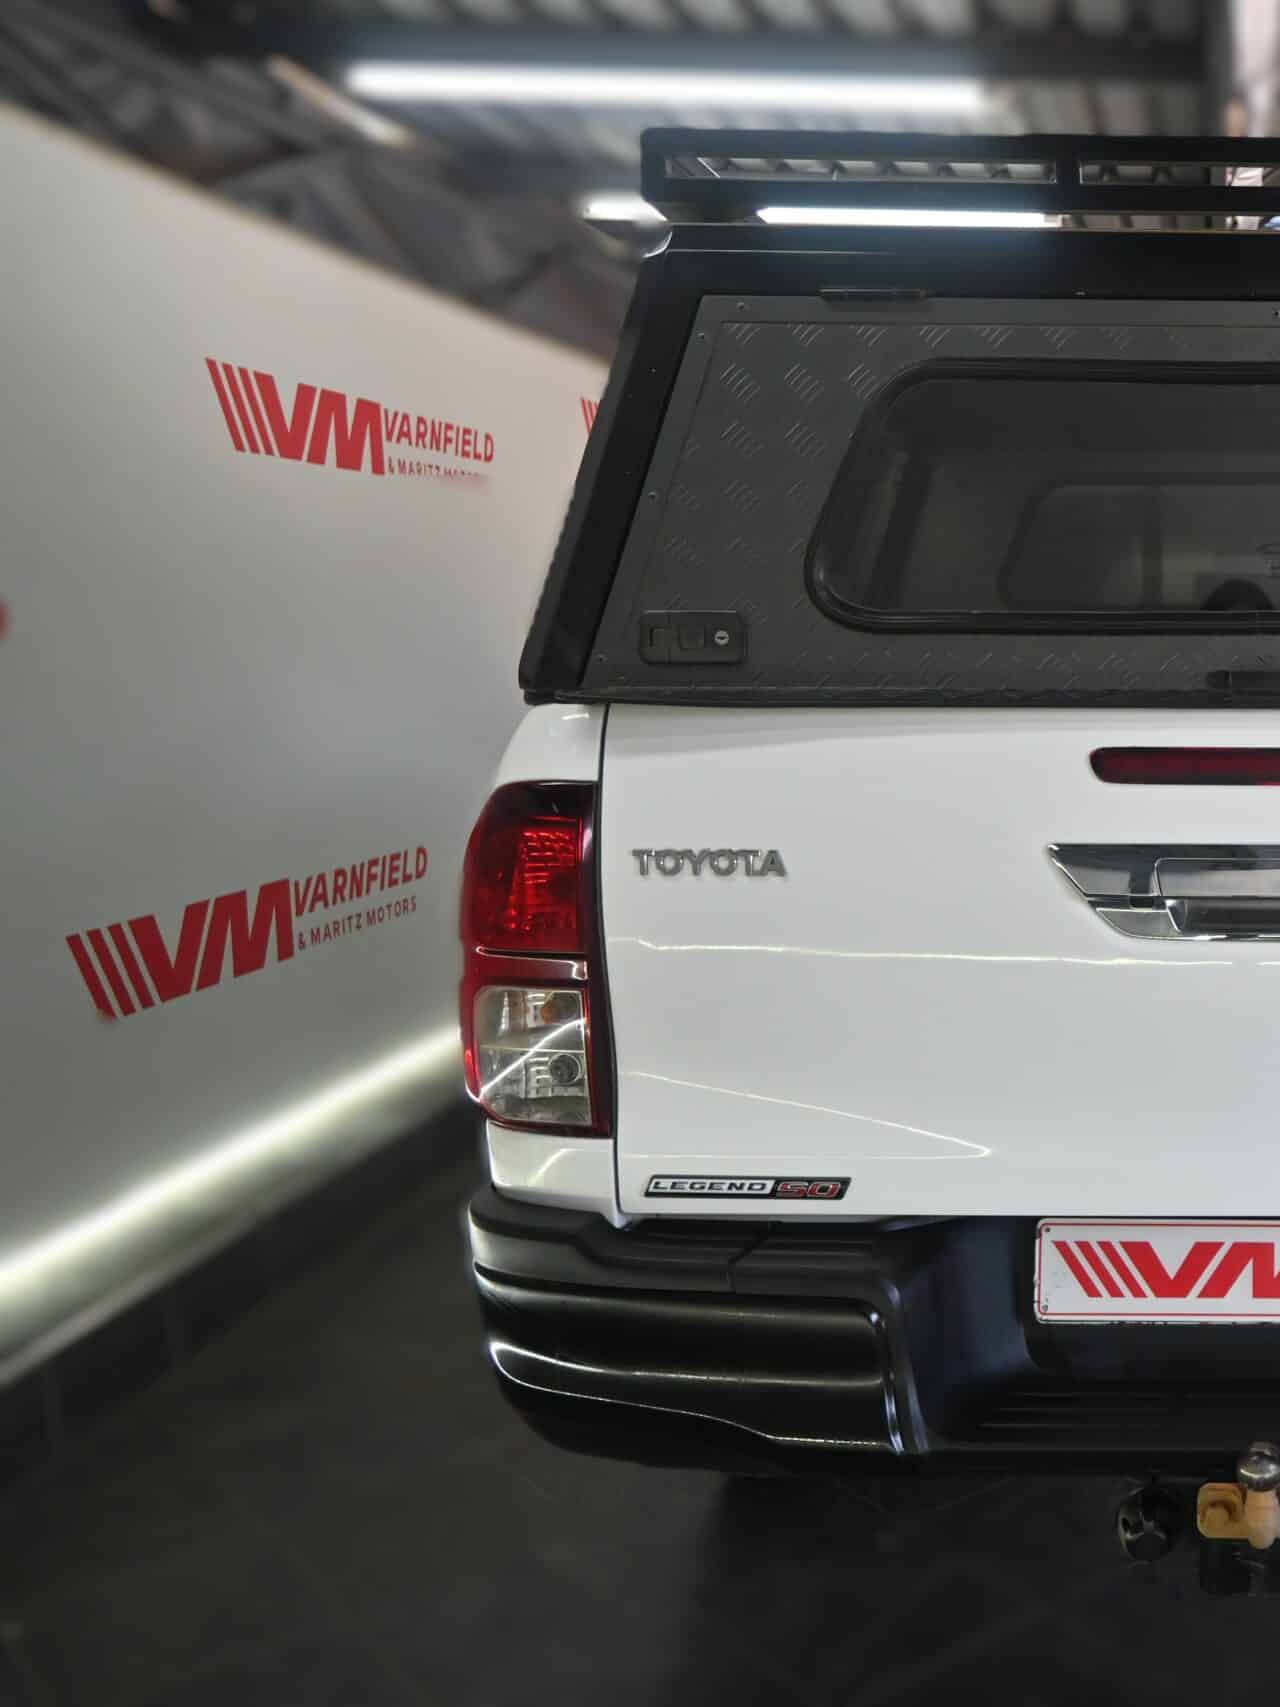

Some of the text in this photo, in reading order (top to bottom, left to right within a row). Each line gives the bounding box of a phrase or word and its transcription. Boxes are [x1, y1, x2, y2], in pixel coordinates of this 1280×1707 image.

[252, 368, 385, 477] VM
[384, 407, 495, 463] VARNFIELD
[294, 846, 428, 917] VARNFIELD
[632, 848, 786, 877] TOYOTA
[126, 877, 295, 1003] VM
[298, 896, 417, 950] & MARITZ MOTORS
[652, 1181, 842, 1198] LEGEND 50
